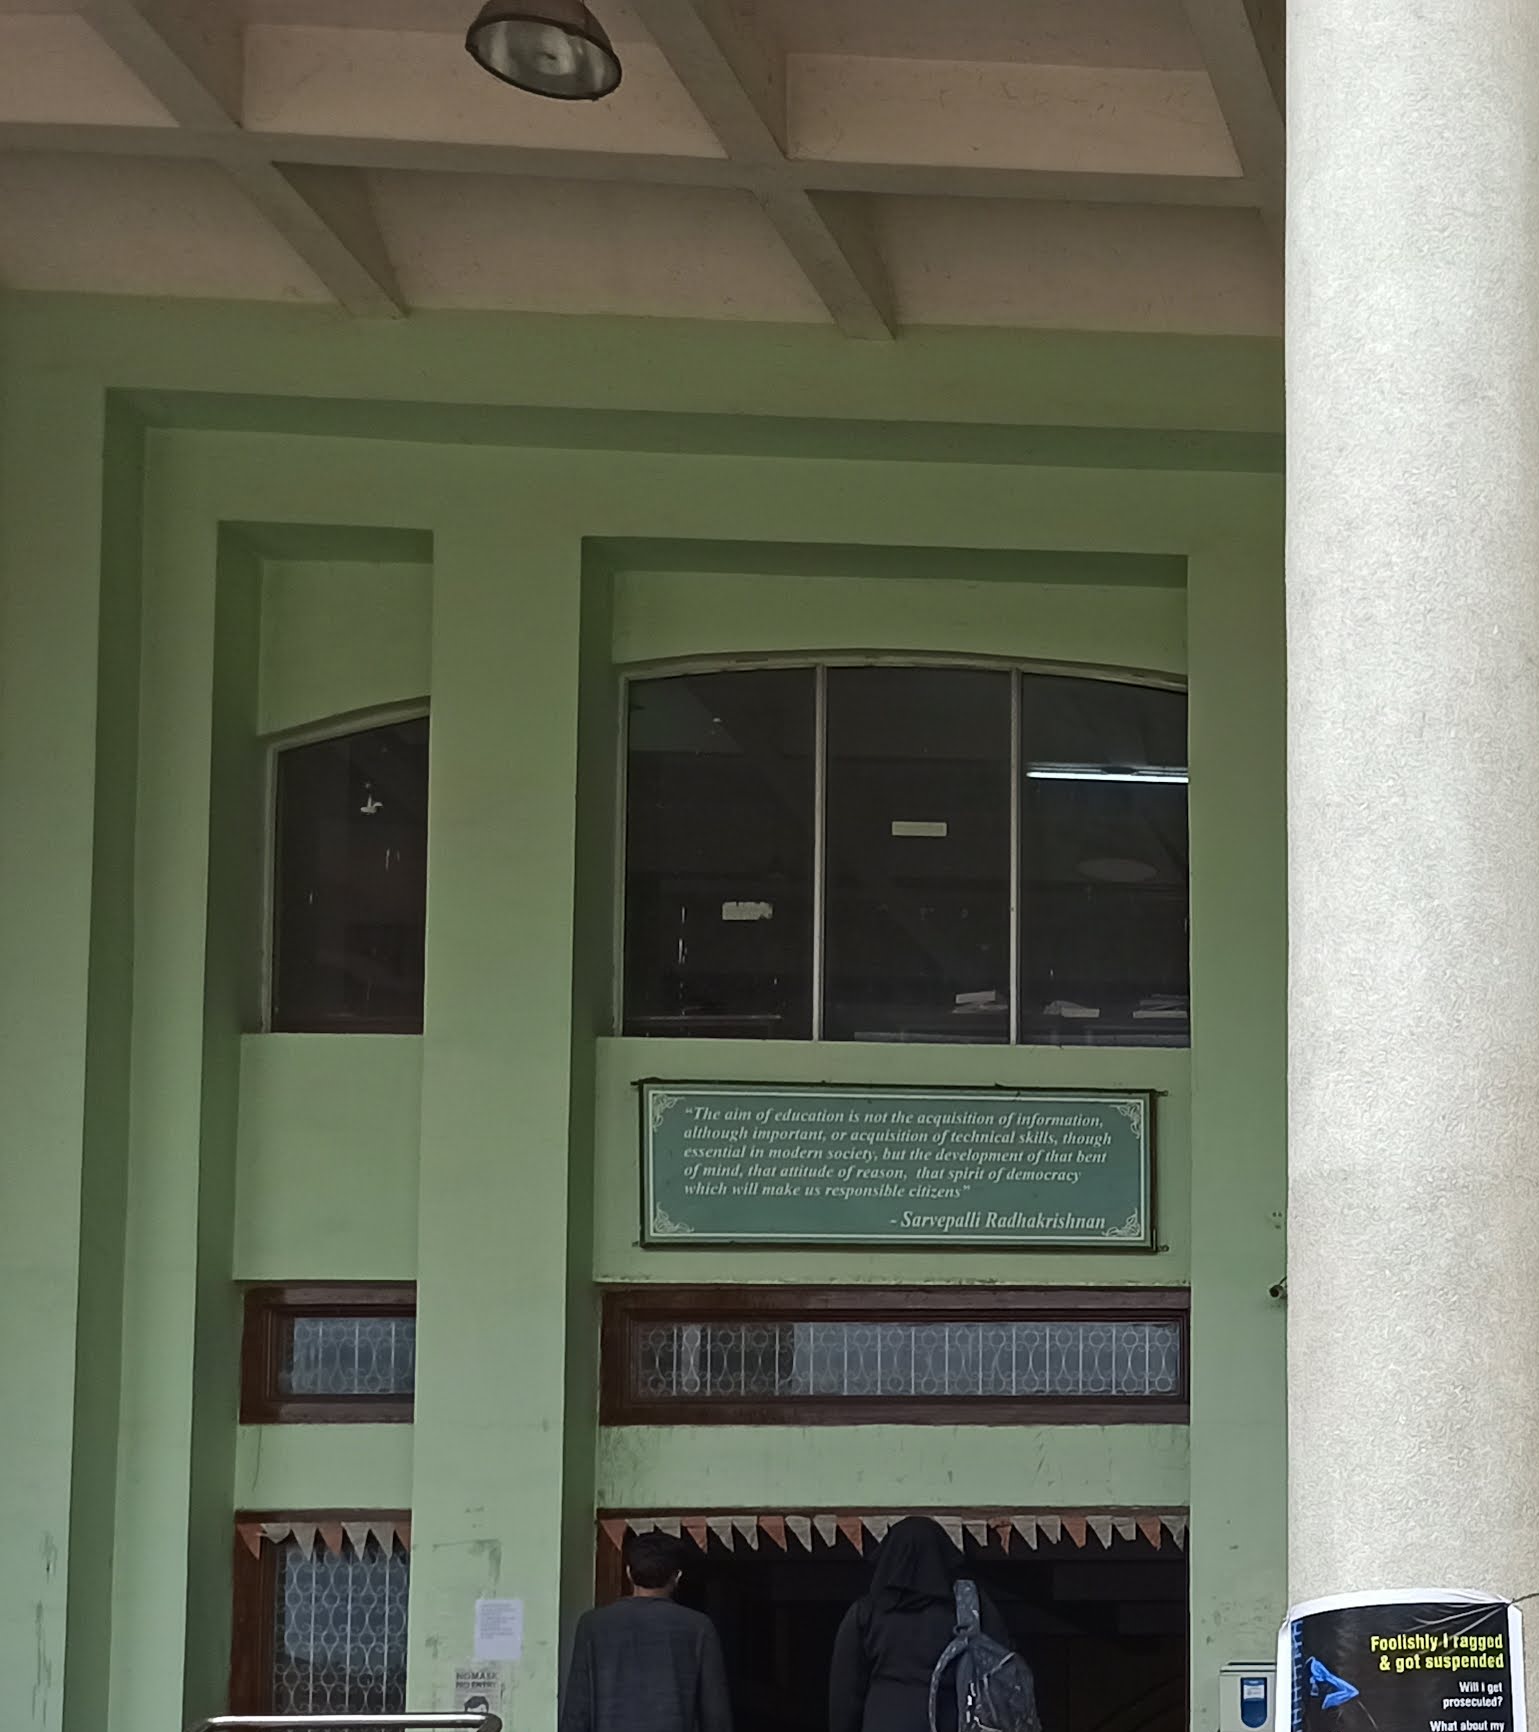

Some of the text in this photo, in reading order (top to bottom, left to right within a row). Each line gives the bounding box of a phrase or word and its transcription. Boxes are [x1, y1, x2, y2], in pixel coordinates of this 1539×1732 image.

[724, 1107, 751, 1122] aim
[755, 1108, 774, 1124] of
[775, 1108, 844, 1123] education
[849, 1110, 860, 1123] is
[863, 1110, 888, 1123] not
[891, 1111, 914, 1125] the
[917, 1112, 994, 1127] acquisition
[998, 1112, 1016, 1128] of
[1016, 1113, 1104, 1129] information,
[684, 1125, 1112, 1147] although important, or acquisition of technical skills, though
[683, 1145, 1107, 1165] essential in modern society, but the development of that bent
[684, 1164, 1081, 1184] of mind, that attitude of reason, that spirit of democracy
[684, 1182, 727, 1195] which
[732, 1182, 759, 1196] will
[762, 1182, 800, 1196] make
[804, 1186, 821, 1196] us
[825, 1183, 905, 1199] responsible
[900, 1210, 981, 1232] Sarvepalli
[985, 1211, 1106, 1230] Radhakrishnan
[1370, 1633, 1439, 1652] Foolishly
[1453, 1633, 1504, 1651] ragged
[1379, 1653, 1505, 1673] & got suspended
[1459, 1681, 1480, 1693] Will
[1487, 1682, 1503, 1695] get
[1442, 1696, 1503, 1710] prosecuted?
[1429, 1720, 1505, 1732] What about my
